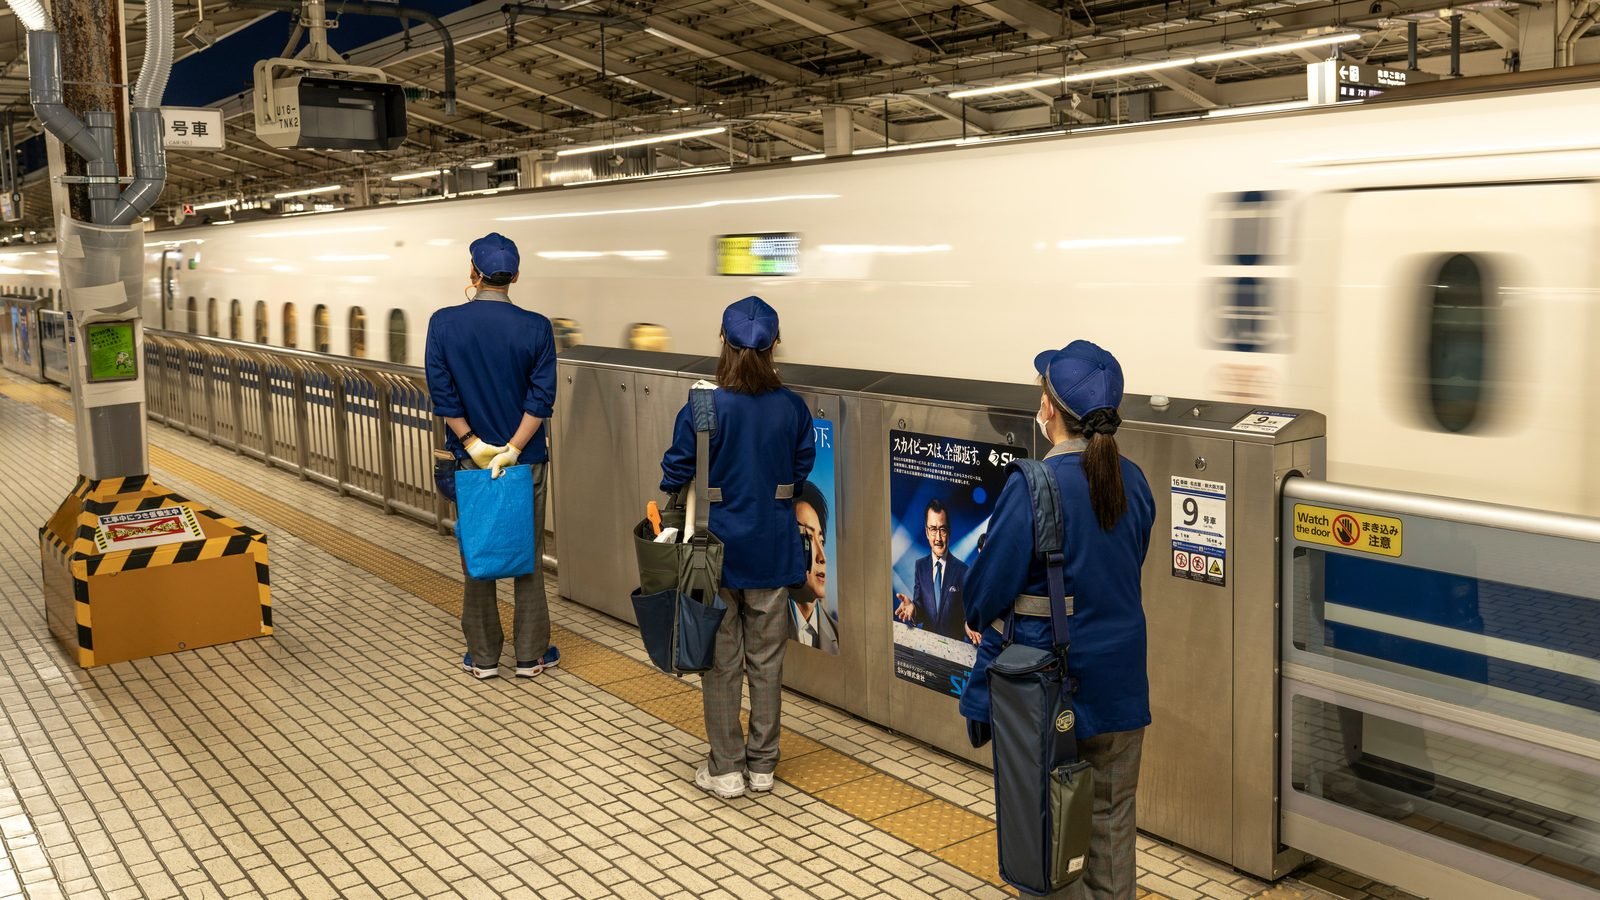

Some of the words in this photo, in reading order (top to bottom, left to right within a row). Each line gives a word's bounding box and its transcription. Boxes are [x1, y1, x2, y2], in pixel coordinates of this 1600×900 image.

[171, 120, 209, 137] 号車
[279, 117, 299, 129] TNK2
[1253, 416, 1270, 425] 9
[893, 436, 981, 467] スカイピースは、全部返す。
[1001, 452, 1020, 467] Sk
[1182, 497, 1199, 526] 9
[1297, 511, 1330, 527] Watch
[1296, 524, 1310, 535] the
[1311, 526, 1331, 538] door
[1361, 521, 1399, 537] まき込み
[1368, 534, 1392, 550] 注意
